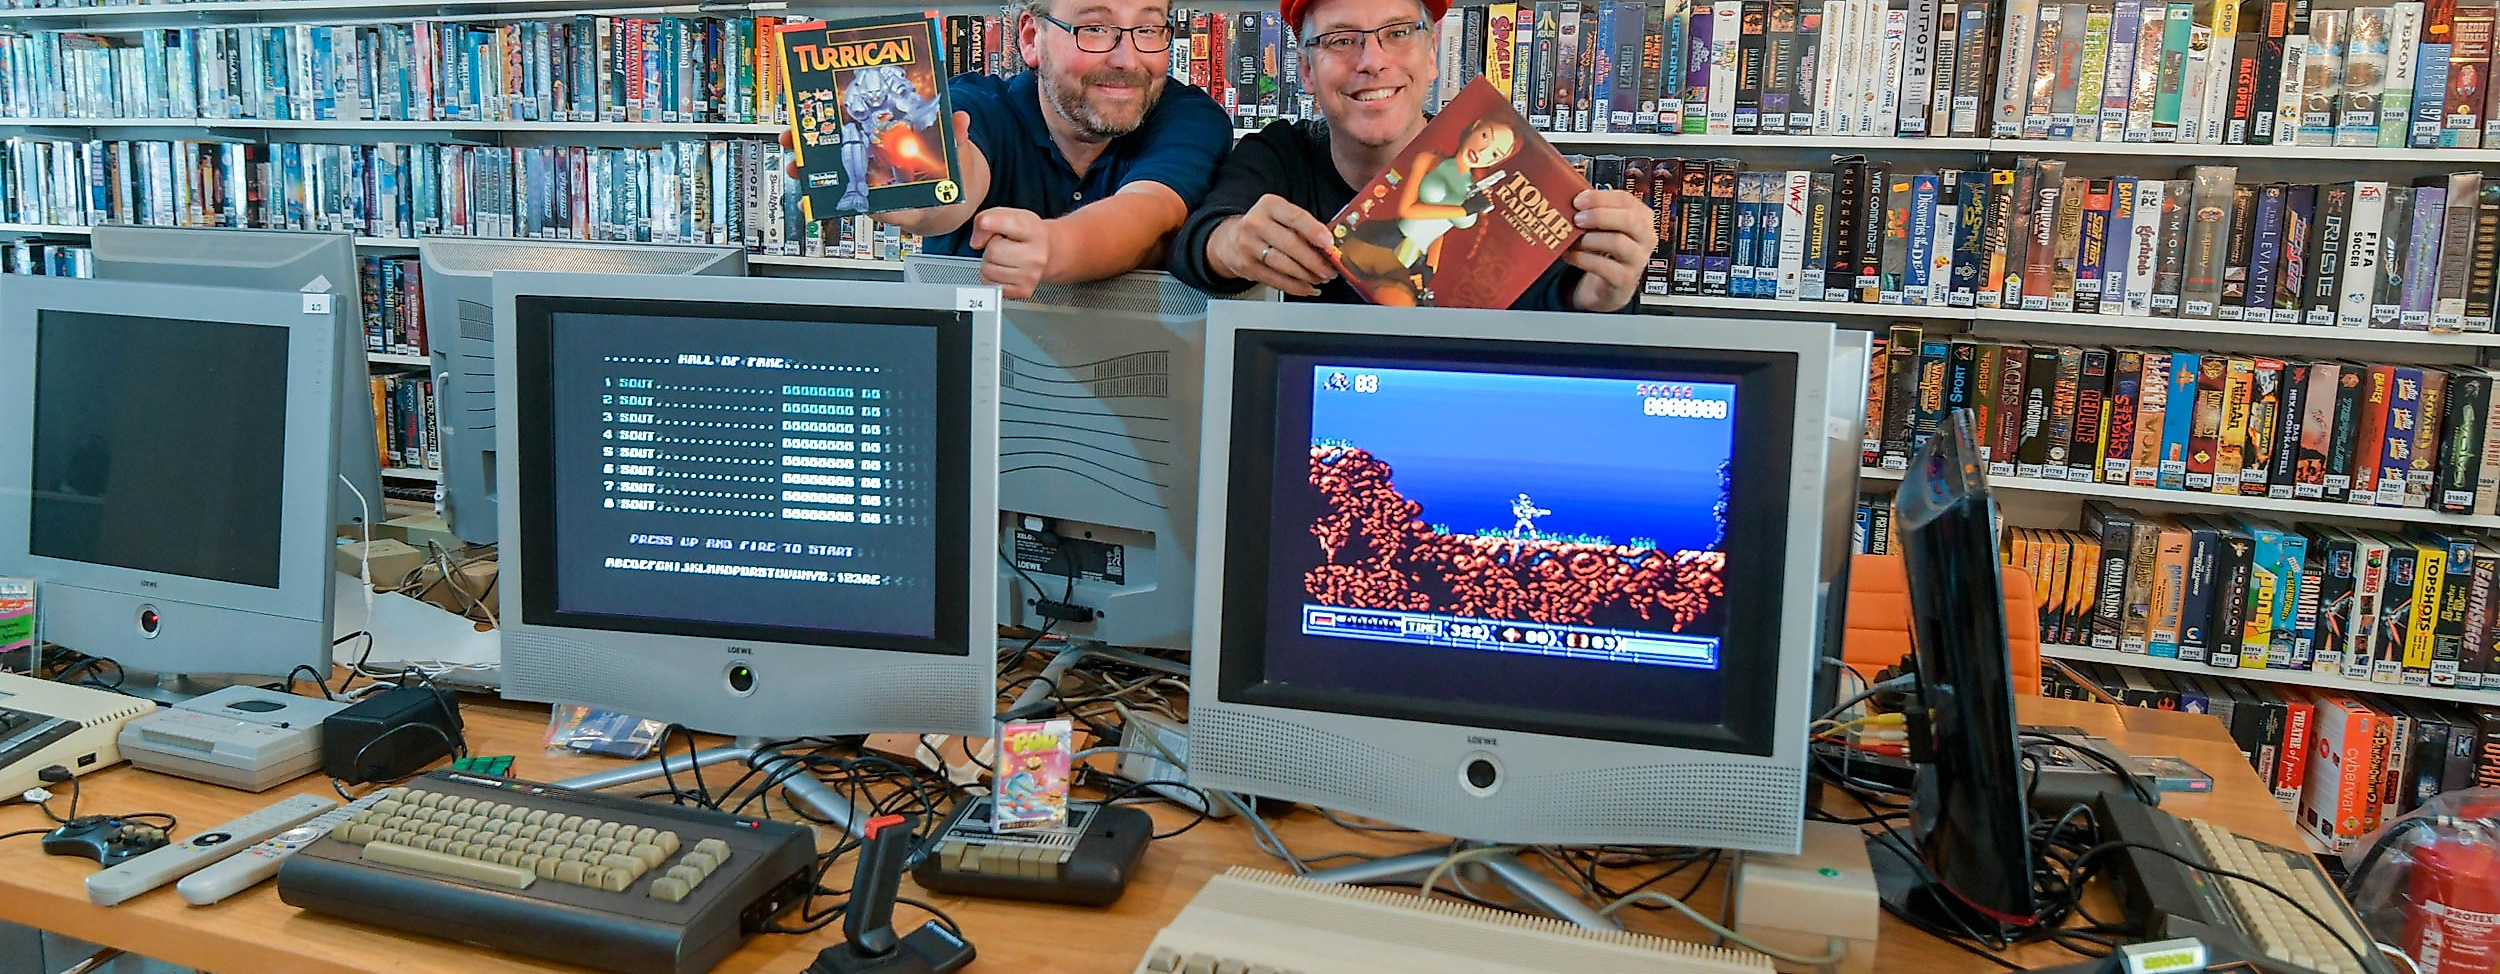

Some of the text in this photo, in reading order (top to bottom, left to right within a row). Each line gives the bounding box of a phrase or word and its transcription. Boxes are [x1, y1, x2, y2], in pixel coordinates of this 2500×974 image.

[793, 40, 911, 73] TURRICAN
[972, 20, 982, 63] TRILOGY
[1491, 16, 1513, 62] SPACE
[1537, 30, 1555, 38] ATARI
[1668, 18, 1680, 94] WETLANDS
[1914, 0, 1931, 77] UTPOST 2
[1240, 56, 1256, 85] guilty
[1748, 48, 1759, 83] DEADLOCK
[1777, 39, 1790, 82] DEADLOCK
[1968, 29, 1984, 97] MILLENNI
[2431, 48, 2449, 107] HARPOON
[2234, 58, 2252, 118] MACS OPERA
[2420, 107, 2442, 121] 97
[1495, 185, 1550, 240] RAIDER
[1507, 170, 1573, 241] TOMB
[1653, 180, 1663, 208] HUMAN
[1866, 171, 1882, 254] WING COMMANDER
[2037, 188, 2059, 246] Conqueror
[2141, 198, 2157, 207] PC
[1688, 203, 1702, 243] DEADLOCK
[1717, 204, 1731, 245] DEADLOCK
[1811, 204, 1824, 259] OLDTIMER
[1912, 193, 1933, 284] Discoveries DEEP
[1995, 193, 2010, 249] forced
[2092, 212, 2105, 239] STAR
[1979, 226, 1996, 287] alliance
[2253, 231, 2276, 305] LEVIATHA
[2316, 216, 2342, 297] RISE
[2349, 231, 2363, 267] SOCCER
[2363, 232, 2377, 268] FIFA
[969, 299, 983, 308] 2/4
[677, 354, 714, 366] HALL
[721, 355, 740, 367] OF
[1355, 376, 1379, 394] 03
[1950, 365, 1966, 403] SPORT
[1978, 357, 1990, 391] FORCES
[2001, 357, 2022, 406] ACES
[1644, 397, 1727, 420] 0000000
[1928, 362, 1945, 411] WARCRAFT
[2075, 389, 2100, 443] REDLINE
[2109, 394, 2129, 459] KNIGHT'S
[2118, 405, 2134, 452] CHASE
[2279, 389, 2297, 476] HEXACON-KARTELL
[2291, 424, 2300, 442] DAS
[630, 533, 854, 558] PRESS UP AND FIRE TO START
[2104, 557, 2125, 619] COMMANDOS
[2246, 571, 2272, 629] pong
[2296, 574, 2321, 631] BOMBER
[2420, 557, 2440, 631] TOPSHOTS
[2463, 571, 2493, 653] EARTHSIEGE
[1407, 622, 1615, 650] TIME 322 00 03
[2281, 710, 2306, 781] THEATRE of pain
[2342, 748, 2360, 813] cyberwar
[2446, 908, 2493, 923] PROTEX
